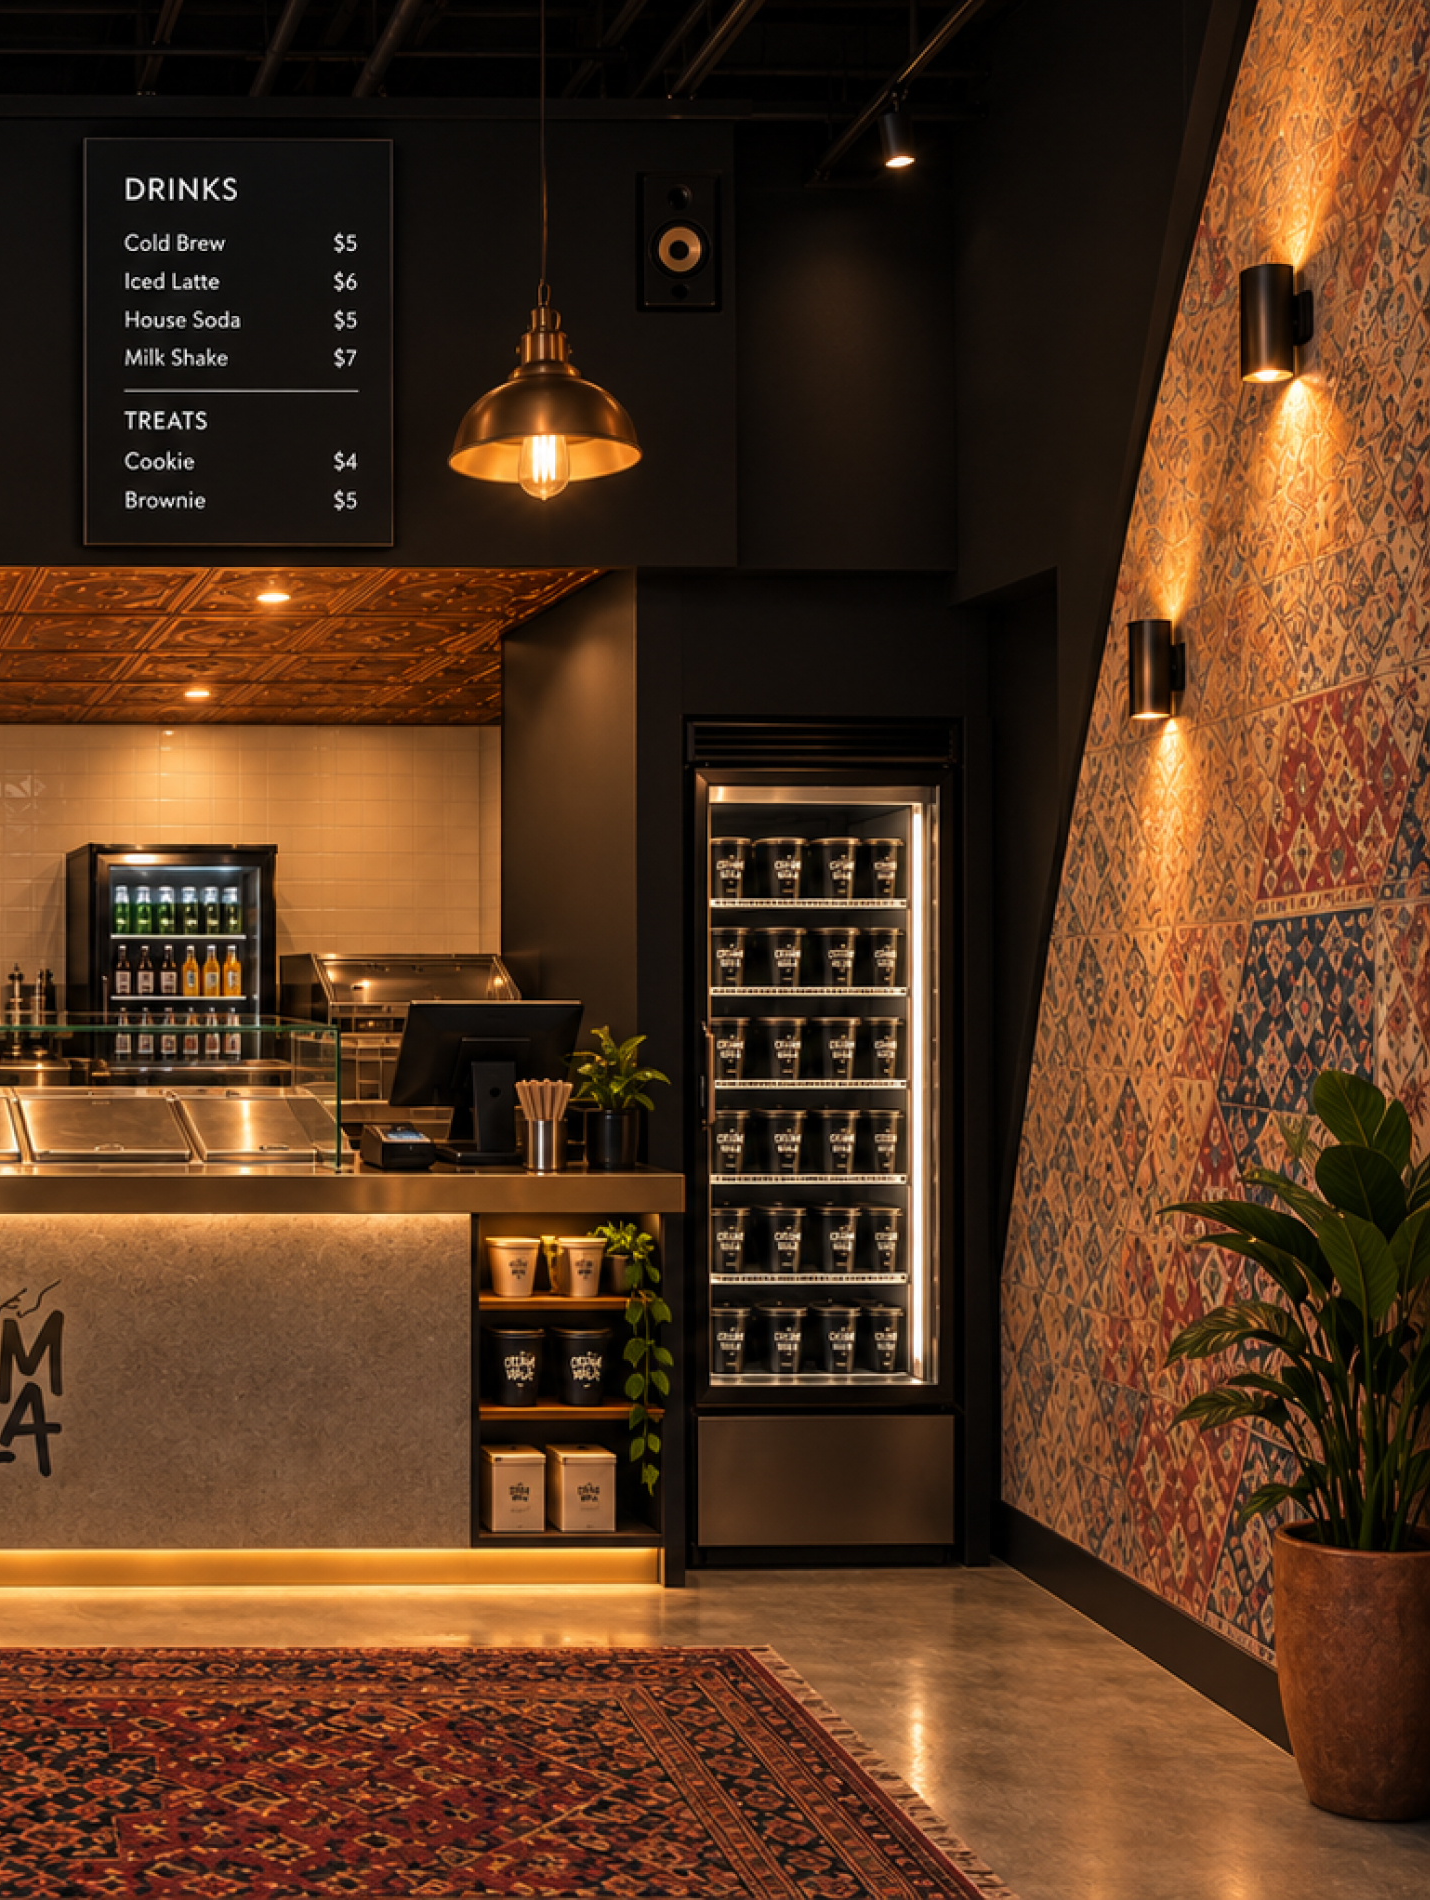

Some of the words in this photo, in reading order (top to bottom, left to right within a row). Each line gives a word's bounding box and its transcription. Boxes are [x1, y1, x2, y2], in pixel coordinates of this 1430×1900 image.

[125, 176, 238, 202] DRINKS
[123, 233, 171, 252] Cold
[176, 233, 227, 252] Brew
[333, 231, 357, 254] $5
[124, 271, 166, 291] Iced
[171, 272, 221, 291] Latte
[333, 270, 359, 293] $6
[124, 310, 188, 330] House
[192, 309, 242, 330] Soda
[333, 309, 358, 332] $5
[124, 347, 166, 367] Milk
[171, 347, 229, 367] Shake
[333, 347, 357, 369] $7
[123, 410, 208, 431] TREATS
[124, 450, 195, 471] Cookie
[333, 449, 358, 472] $4
[124, 490, 207, 510] Brownie
[333, 488, 358, 512] $5
